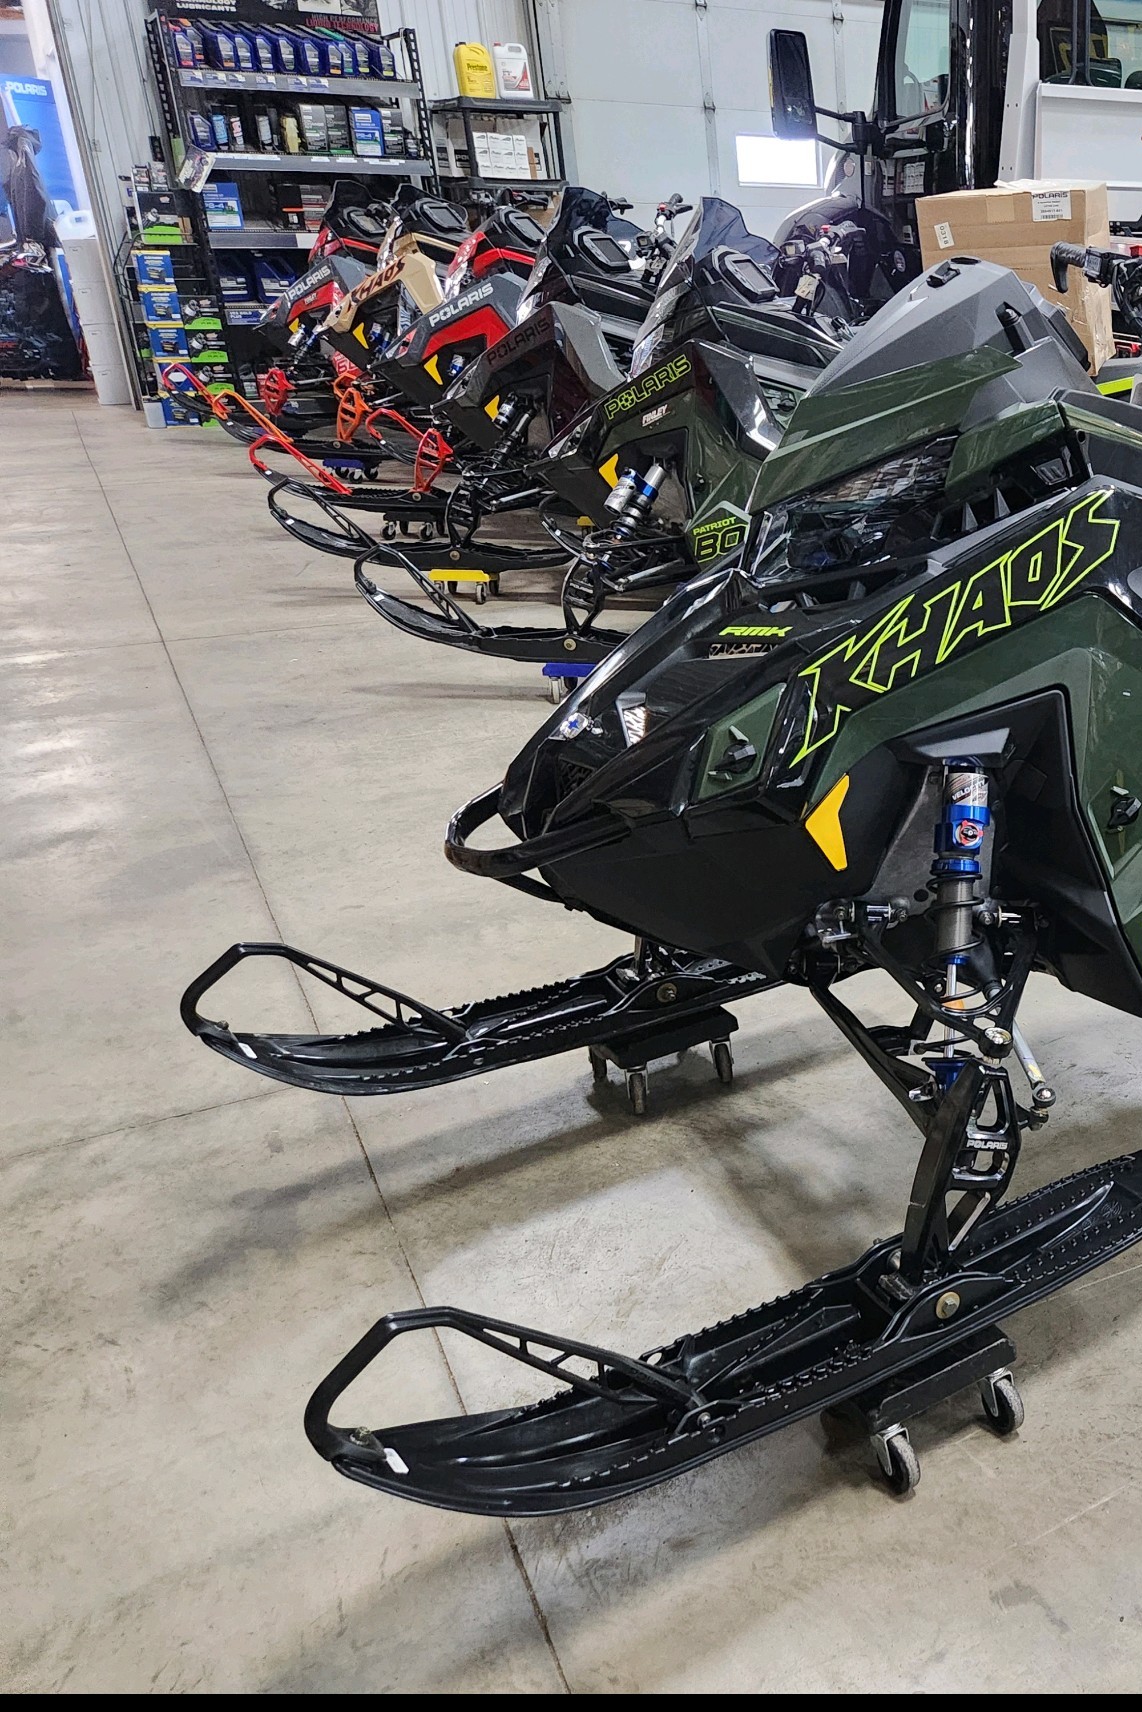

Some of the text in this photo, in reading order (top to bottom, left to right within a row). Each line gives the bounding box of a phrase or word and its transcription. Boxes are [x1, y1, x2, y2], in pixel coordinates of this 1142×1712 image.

[176, 2, 237, 12] LUBRICANTS
[6, 81, 47, 96] POLARIS
[1032, 191, 1068, 200] POLARIS
[288, 266, 331, 299] POLARIS
[351, 260, 405, 301] KHAOS
[428, 282, 494, 328] POLARIS
[486, 317, 552, 366] POLARIS
[603, 353, 692, 420] POLARIS
[642, 404, 668, 425] FINLEY
[693, 516, 737, 536] PATRIOT
[718, 626, 794, 637] RMK
[789, 488, 1121, 769] KHAOS
[966, 1139, 1009, 1150] POLARIS
